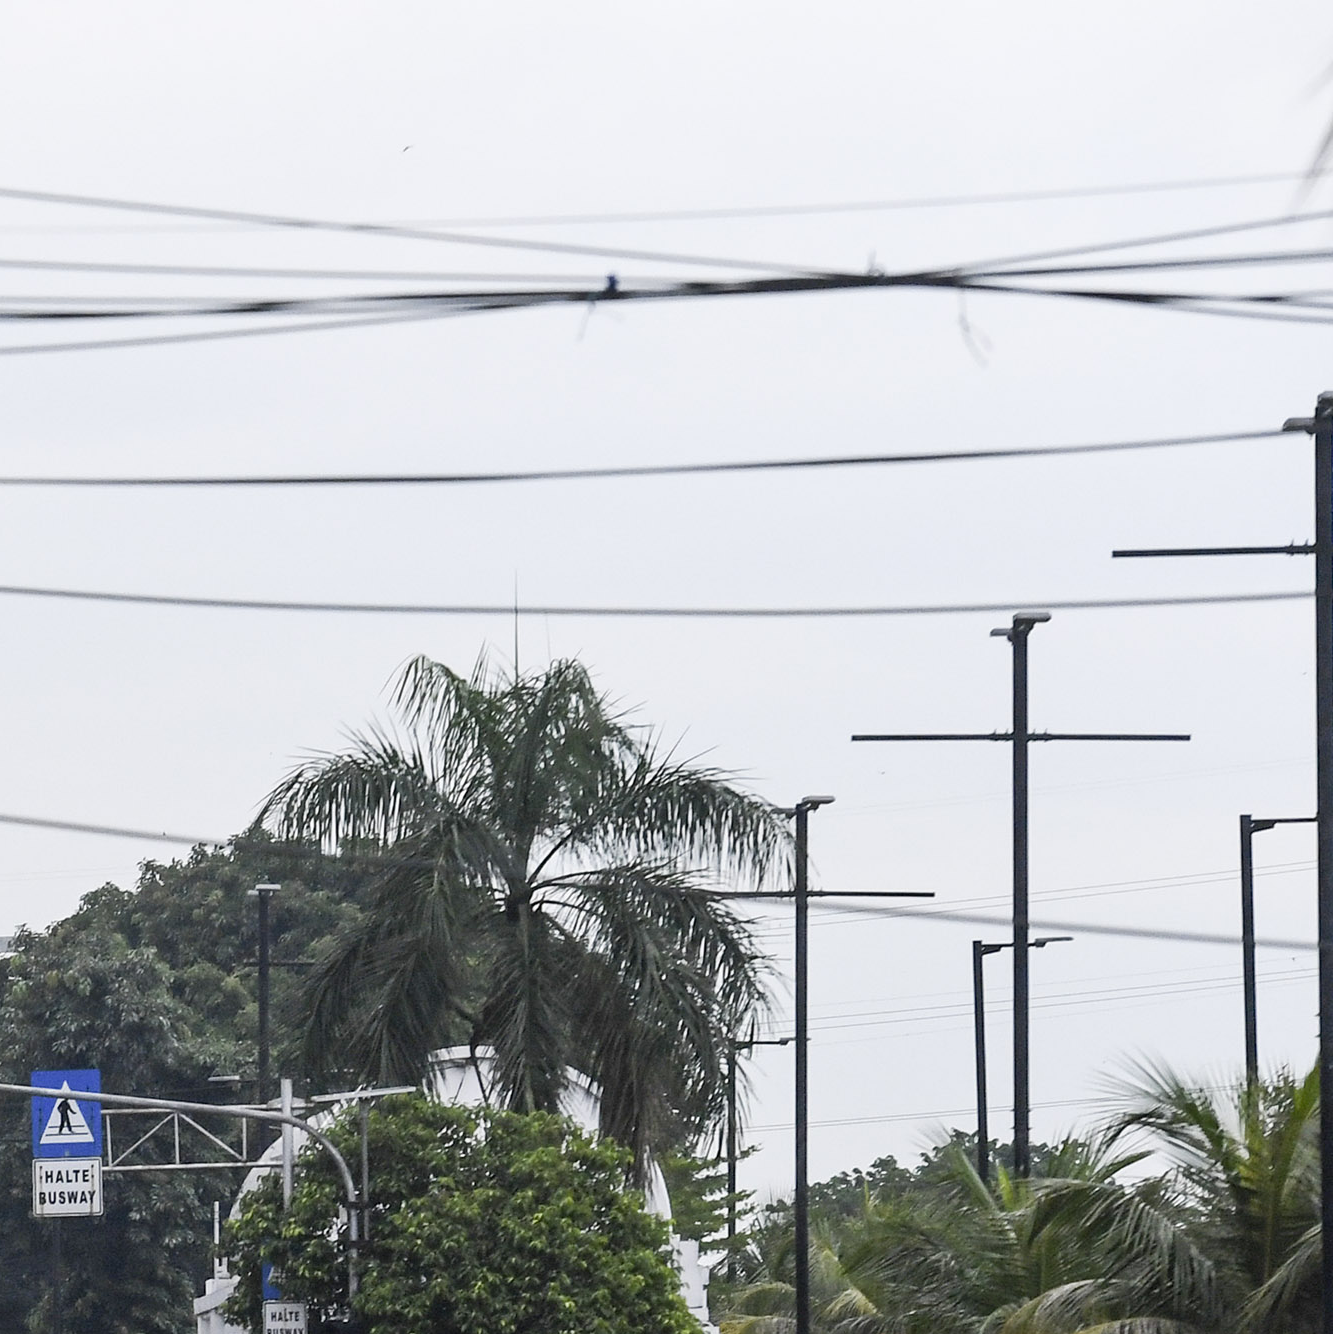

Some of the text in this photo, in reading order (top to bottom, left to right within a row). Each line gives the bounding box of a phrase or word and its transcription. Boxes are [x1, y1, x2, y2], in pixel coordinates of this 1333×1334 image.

[45, 1169, 90, 1184] HALTE
[39, 1190, 96, 1205] BUSWAY
[270, 1311, 300, 1322] HALTE
